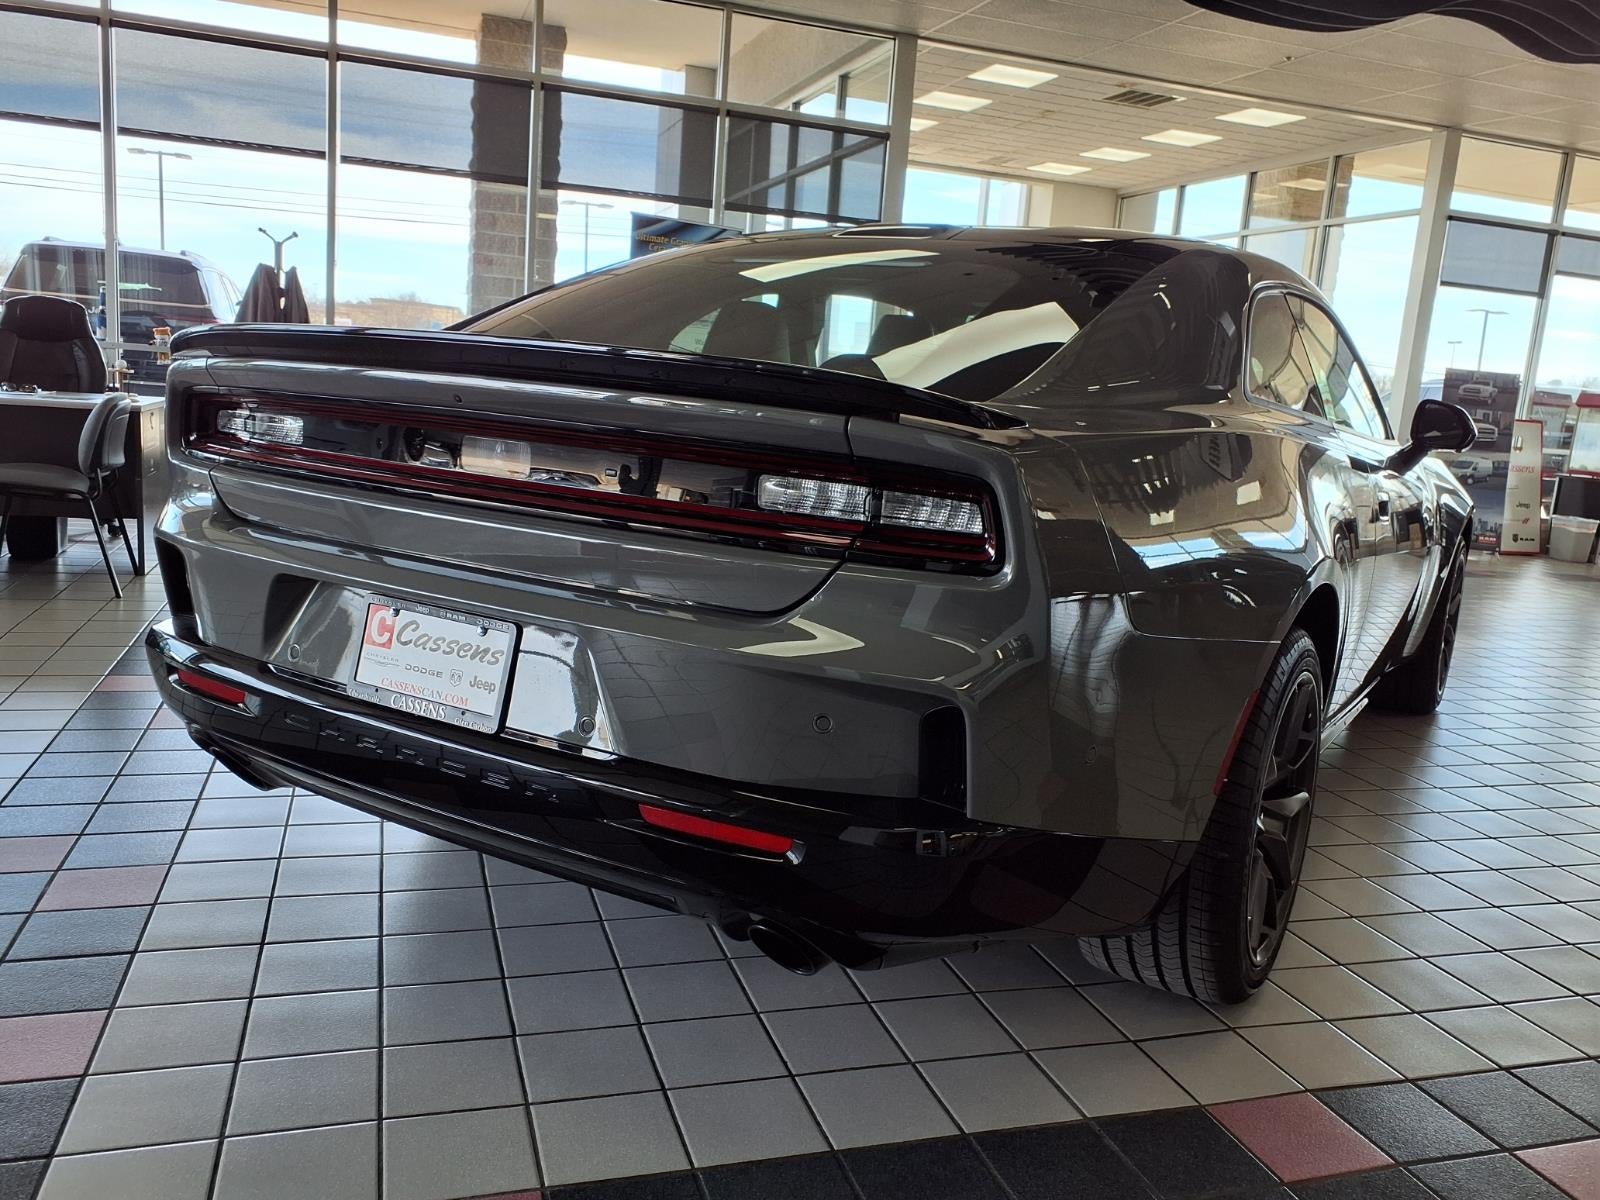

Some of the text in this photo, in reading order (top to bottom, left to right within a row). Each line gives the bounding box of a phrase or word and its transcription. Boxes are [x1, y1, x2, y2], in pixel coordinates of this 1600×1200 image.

[415, 603, 430, 614] Jeep
[446, 612, 466, 622] RAM
[476, 618, 510, 630] DODGE
[396, 619, 505, 666] Cassens
[381, 677, 470, 708] CASSENSCAN.COM
[404, 663, 443, 679] DODGE
[469, 675, 497, 695] Jeep
[390, 693, 447, 721] CASSENS
